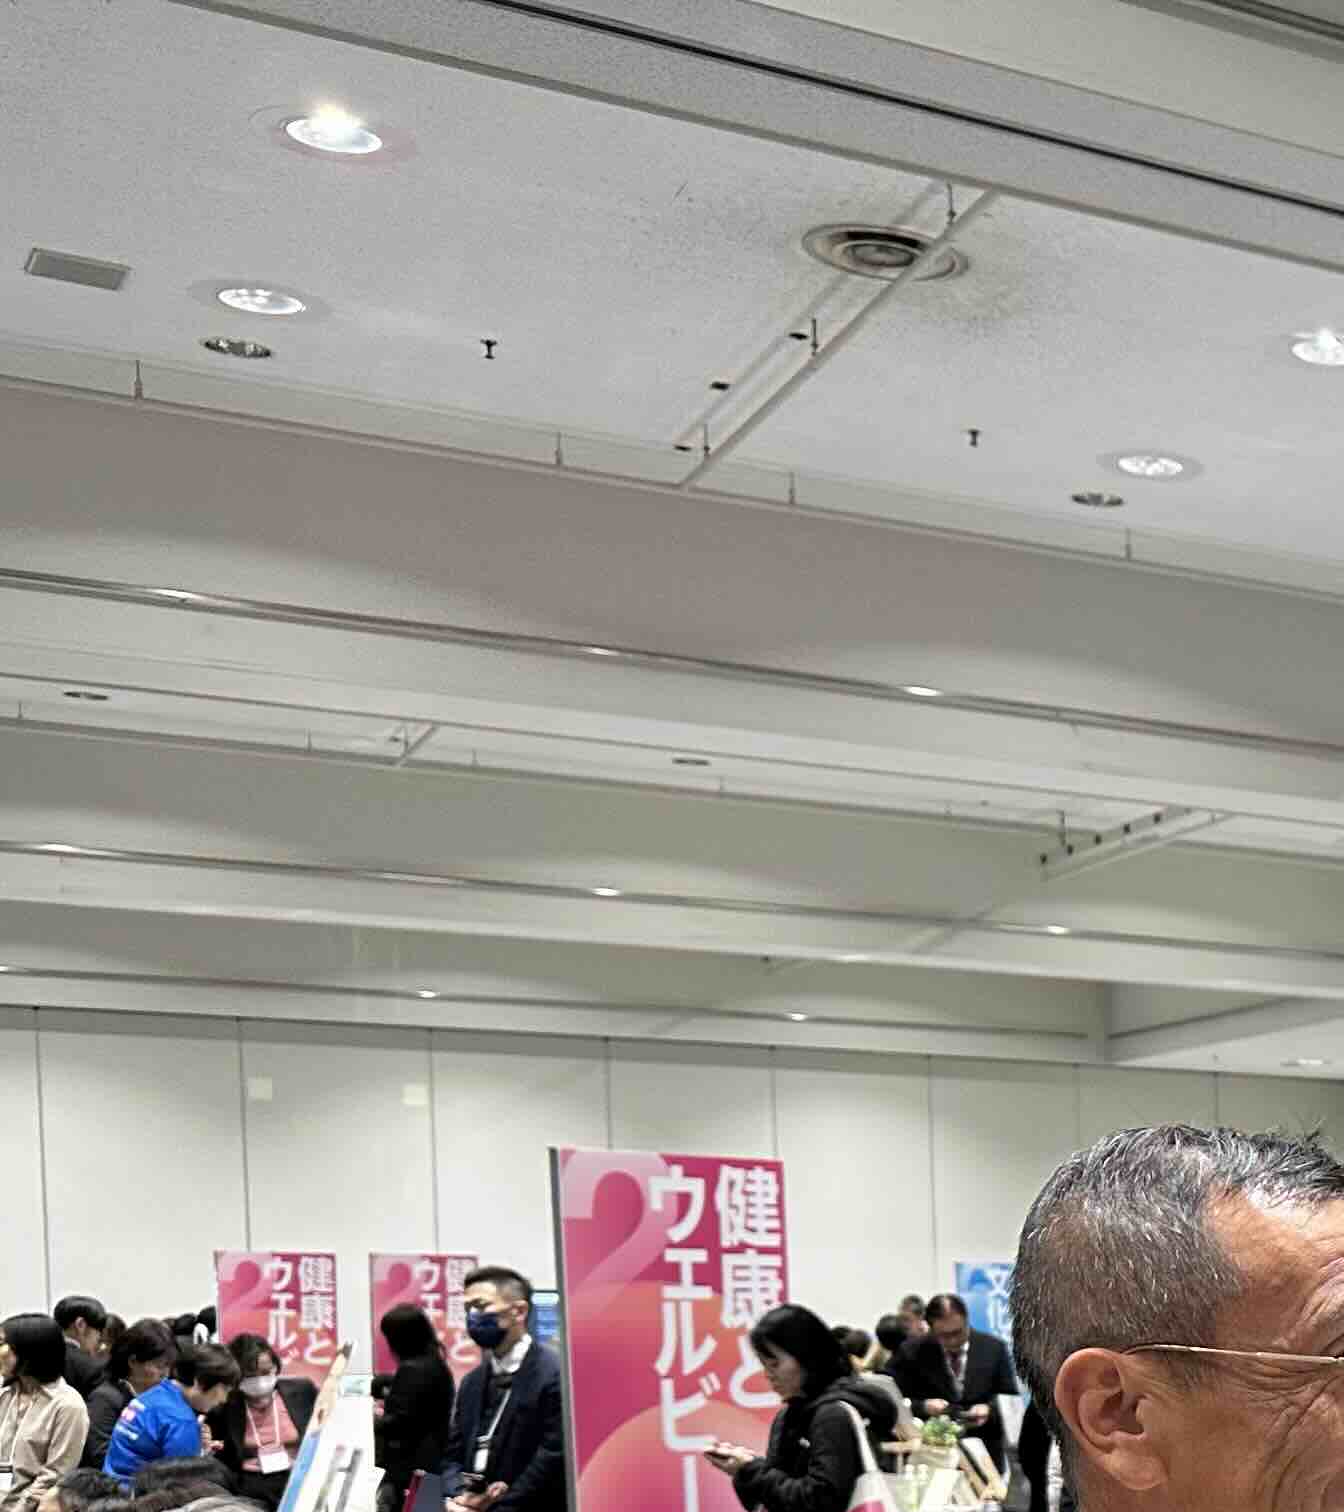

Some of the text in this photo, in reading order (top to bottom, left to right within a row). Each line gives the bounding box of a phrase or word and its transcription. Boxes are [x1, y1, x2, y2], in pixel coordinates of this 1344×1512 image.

[264, 1258, 300, 1364] ウエル
[300, 1257, 336, 1364] 健康と
